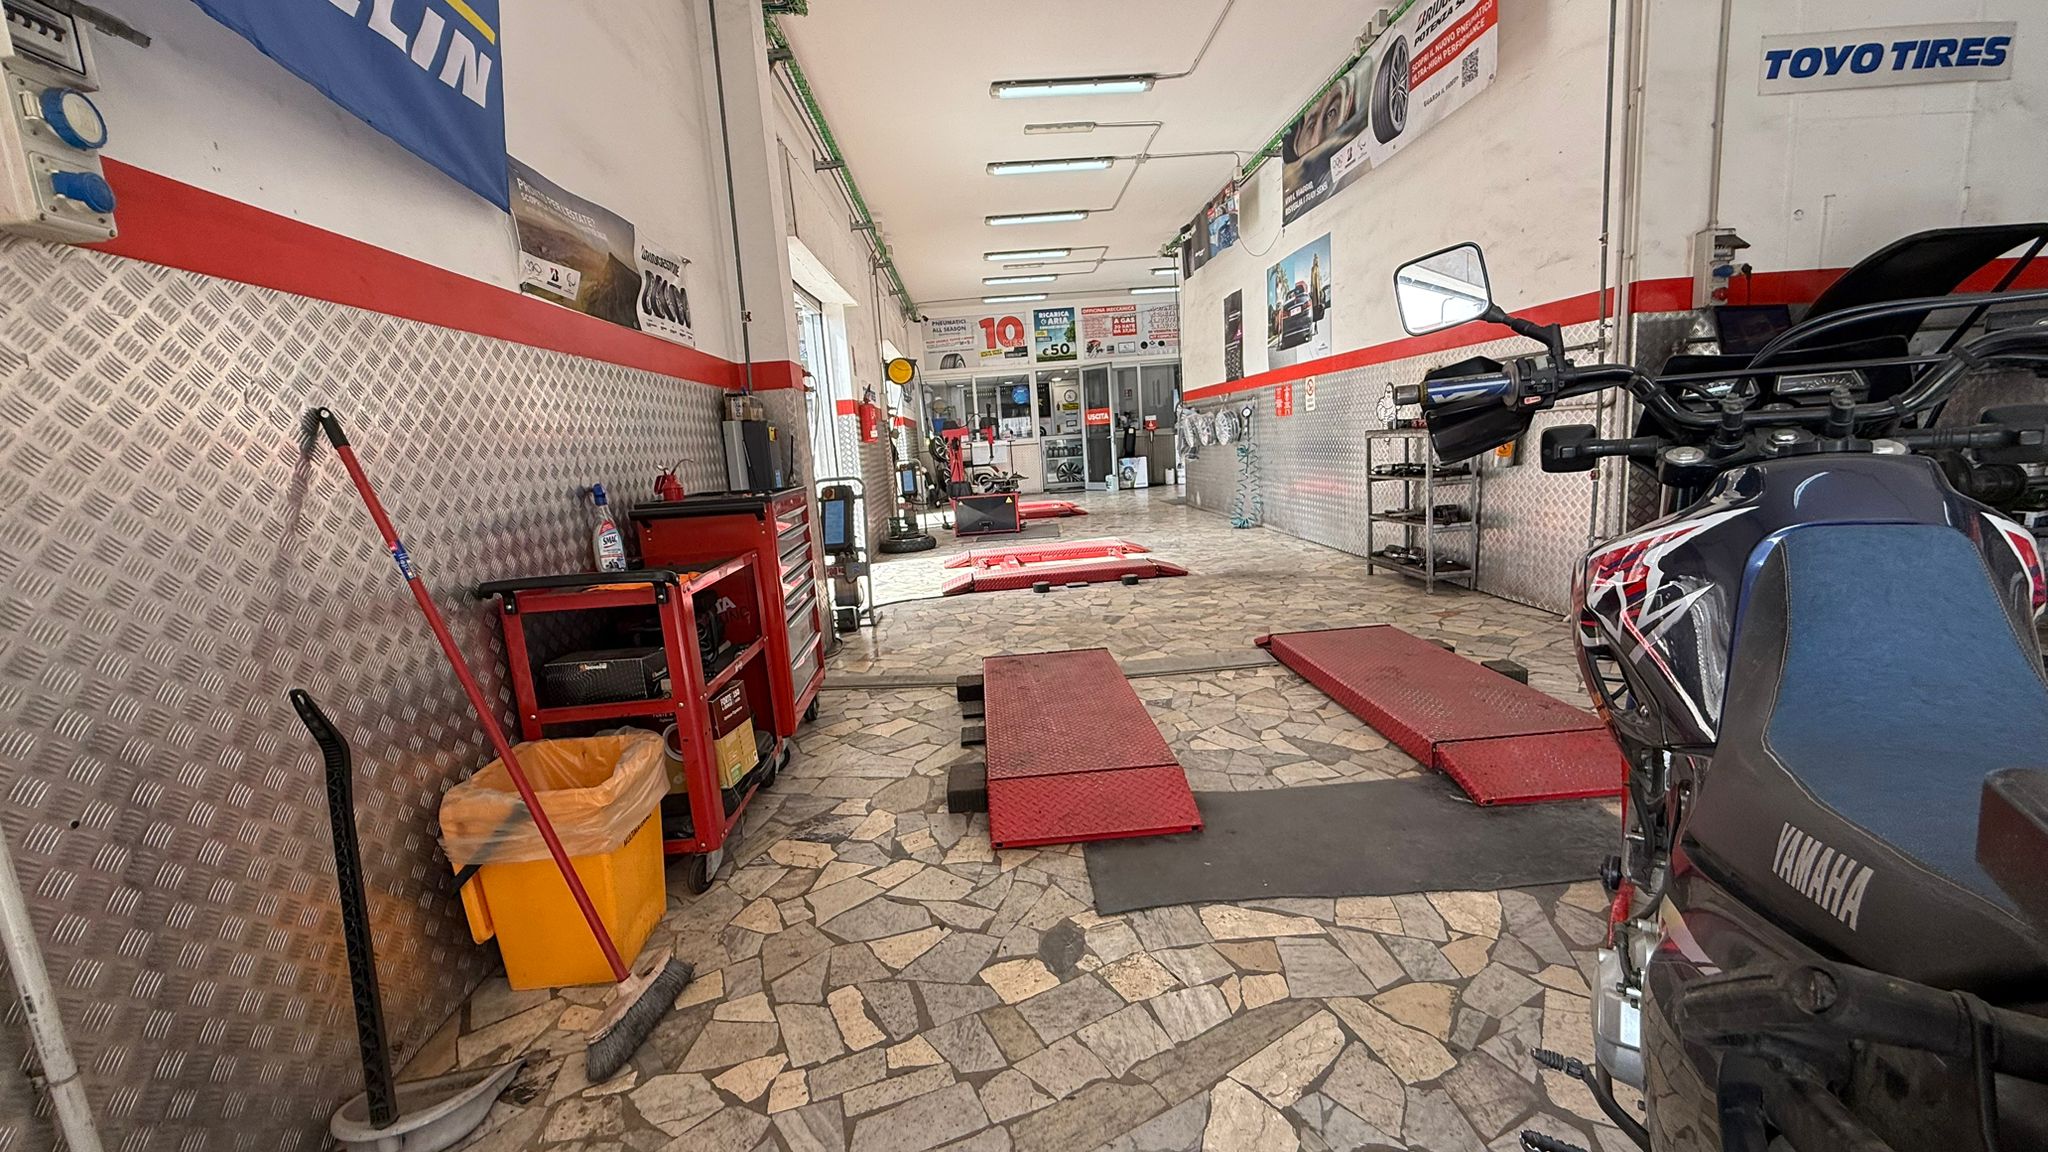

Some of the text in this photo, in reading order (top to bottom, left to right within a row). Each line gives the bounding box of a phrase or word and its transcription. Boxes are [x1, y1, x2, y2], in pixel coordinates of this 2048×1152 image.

[1412, 0, 1493, 73] SCOPRI IL NUOVO PNEUMATICO
[1414, 6, 1453, 47] POTENZA
[329, 0, 492, 109] LIN
[1411, 17, 1486, 84] ULTRA-HIGH PERFORMANCE
[1764, 36, 2012, 80] TOYO TIRES
[978, 316, 1025, 349] 10
[1047, 317, 1069, 325] ARIA
[1050, 343, 1070, 355] 50
[1087, 412, 1109, 420] USCITA
[602, 535, 617, 545] SMAC
[1772, 821, 1875, 932] YAMAHA
